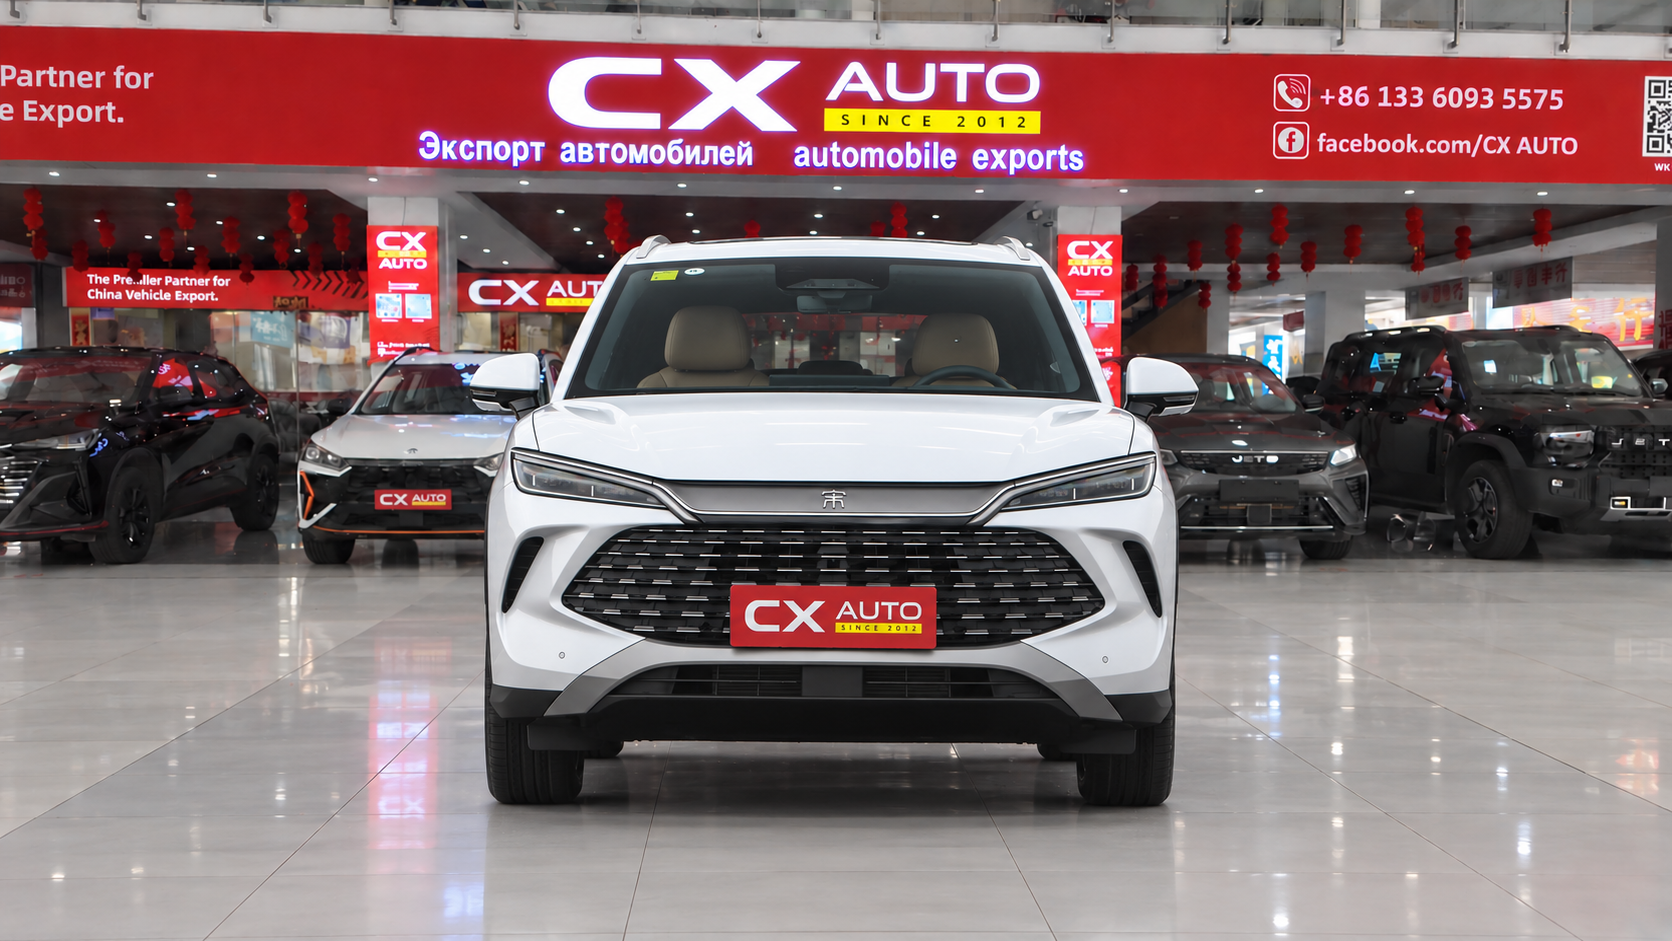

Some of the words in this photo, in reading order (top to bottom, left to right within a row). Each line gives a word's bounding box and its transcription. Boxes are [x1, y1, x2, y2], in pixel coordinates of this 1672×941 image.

[0, 65, 106, 89] Partner
[113, 65, 154, 89] for
[548, 57, 800, 132] CX
[825, 61, 1040, 103] AUTO
[1320, 86, 1370, 107] +86
[1378, 86, 1424, 107] 133
[1432, 87, 1494, 109] 6093
[1502, 88, 1564, 110] 5575
[23, 100, 124, 128] Export.
[841, 114, 931, 127] SINCE
[957, 116, 1026, 128] 2012
[418, 130, 546, 167] Экспорт
[560, 138, 753, 166] автомобилей
[1317, 133, 1511, 157] facebook.com/CX
[1516, 137, 1579, 155] AUTO
[794, 141, 957, 170] automobile
[972, 144, 1085, 175] exports
[376, 231, 426, 251] CX
[1067, 240, 1113, 259] CX
[379, 258, 427, 269] AUTO
[1068, 266, 1113, 276] AUTO
[87, 274, 110, 284] The
[164, 275, 210, 287] Partner
[212, 275, 231, 287] for
[87, 288, 122, 300] China
[124, 288, 171, 301] Vehicle
[175, 290, 219, 303] Export.
[468, 279, 539, 306] CX
[547, 280, 603, 297] AUT
[380, 493, 408, 506] CX
[412, 493, 446, 502] AUTO
[744, 600, 826, 633] CX
[835, 601, 922, 620] AUTO
[841, 624, 878, 632] SINCE
